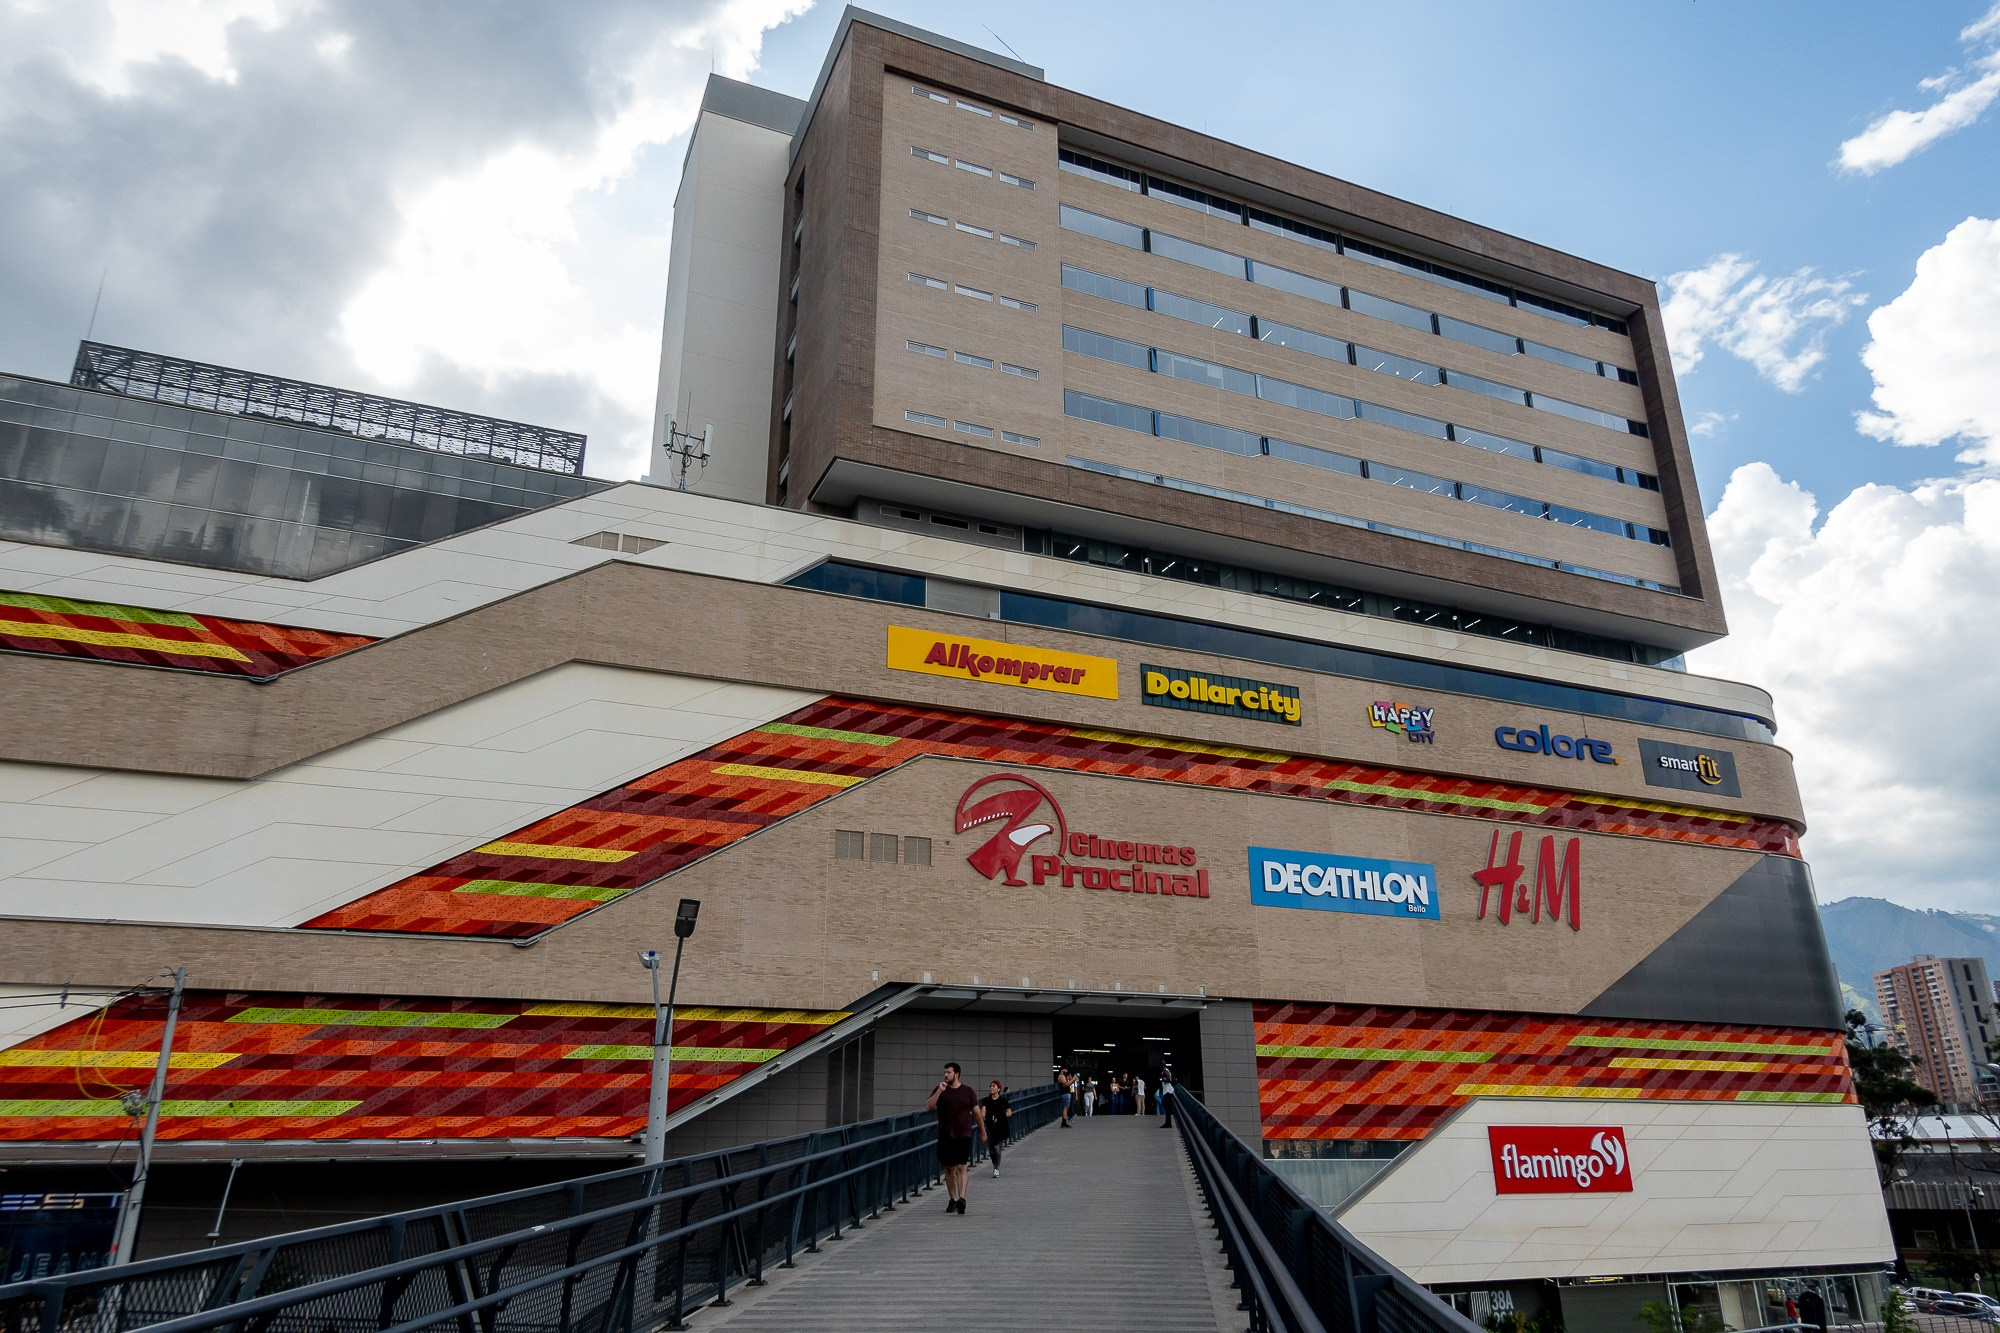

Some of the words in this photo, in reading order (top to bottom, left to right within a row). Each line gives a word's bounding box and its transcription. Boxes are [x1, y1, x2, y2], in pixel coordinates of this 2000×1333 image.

[924, 641, 1086, 685] Alkomprar
[1145, 671, 1301, 722] Dollarcity
[1373, 704, 1435, 728] HAPPY
[1409, 731, 1435, 744] CITY
[1069, 831, 1197, 867] Cinemas
[1032, 854, 1210, 898] Procinal
[1262, 860, 1430, 905] DECATHLON
[1471, 829, 1581, 932] H&M
[1408, 904, 1427, 913] Bello
[1500, 1143, 1604, 1188] flamingo
[1491, 1289, 1514, 1310] 38A
